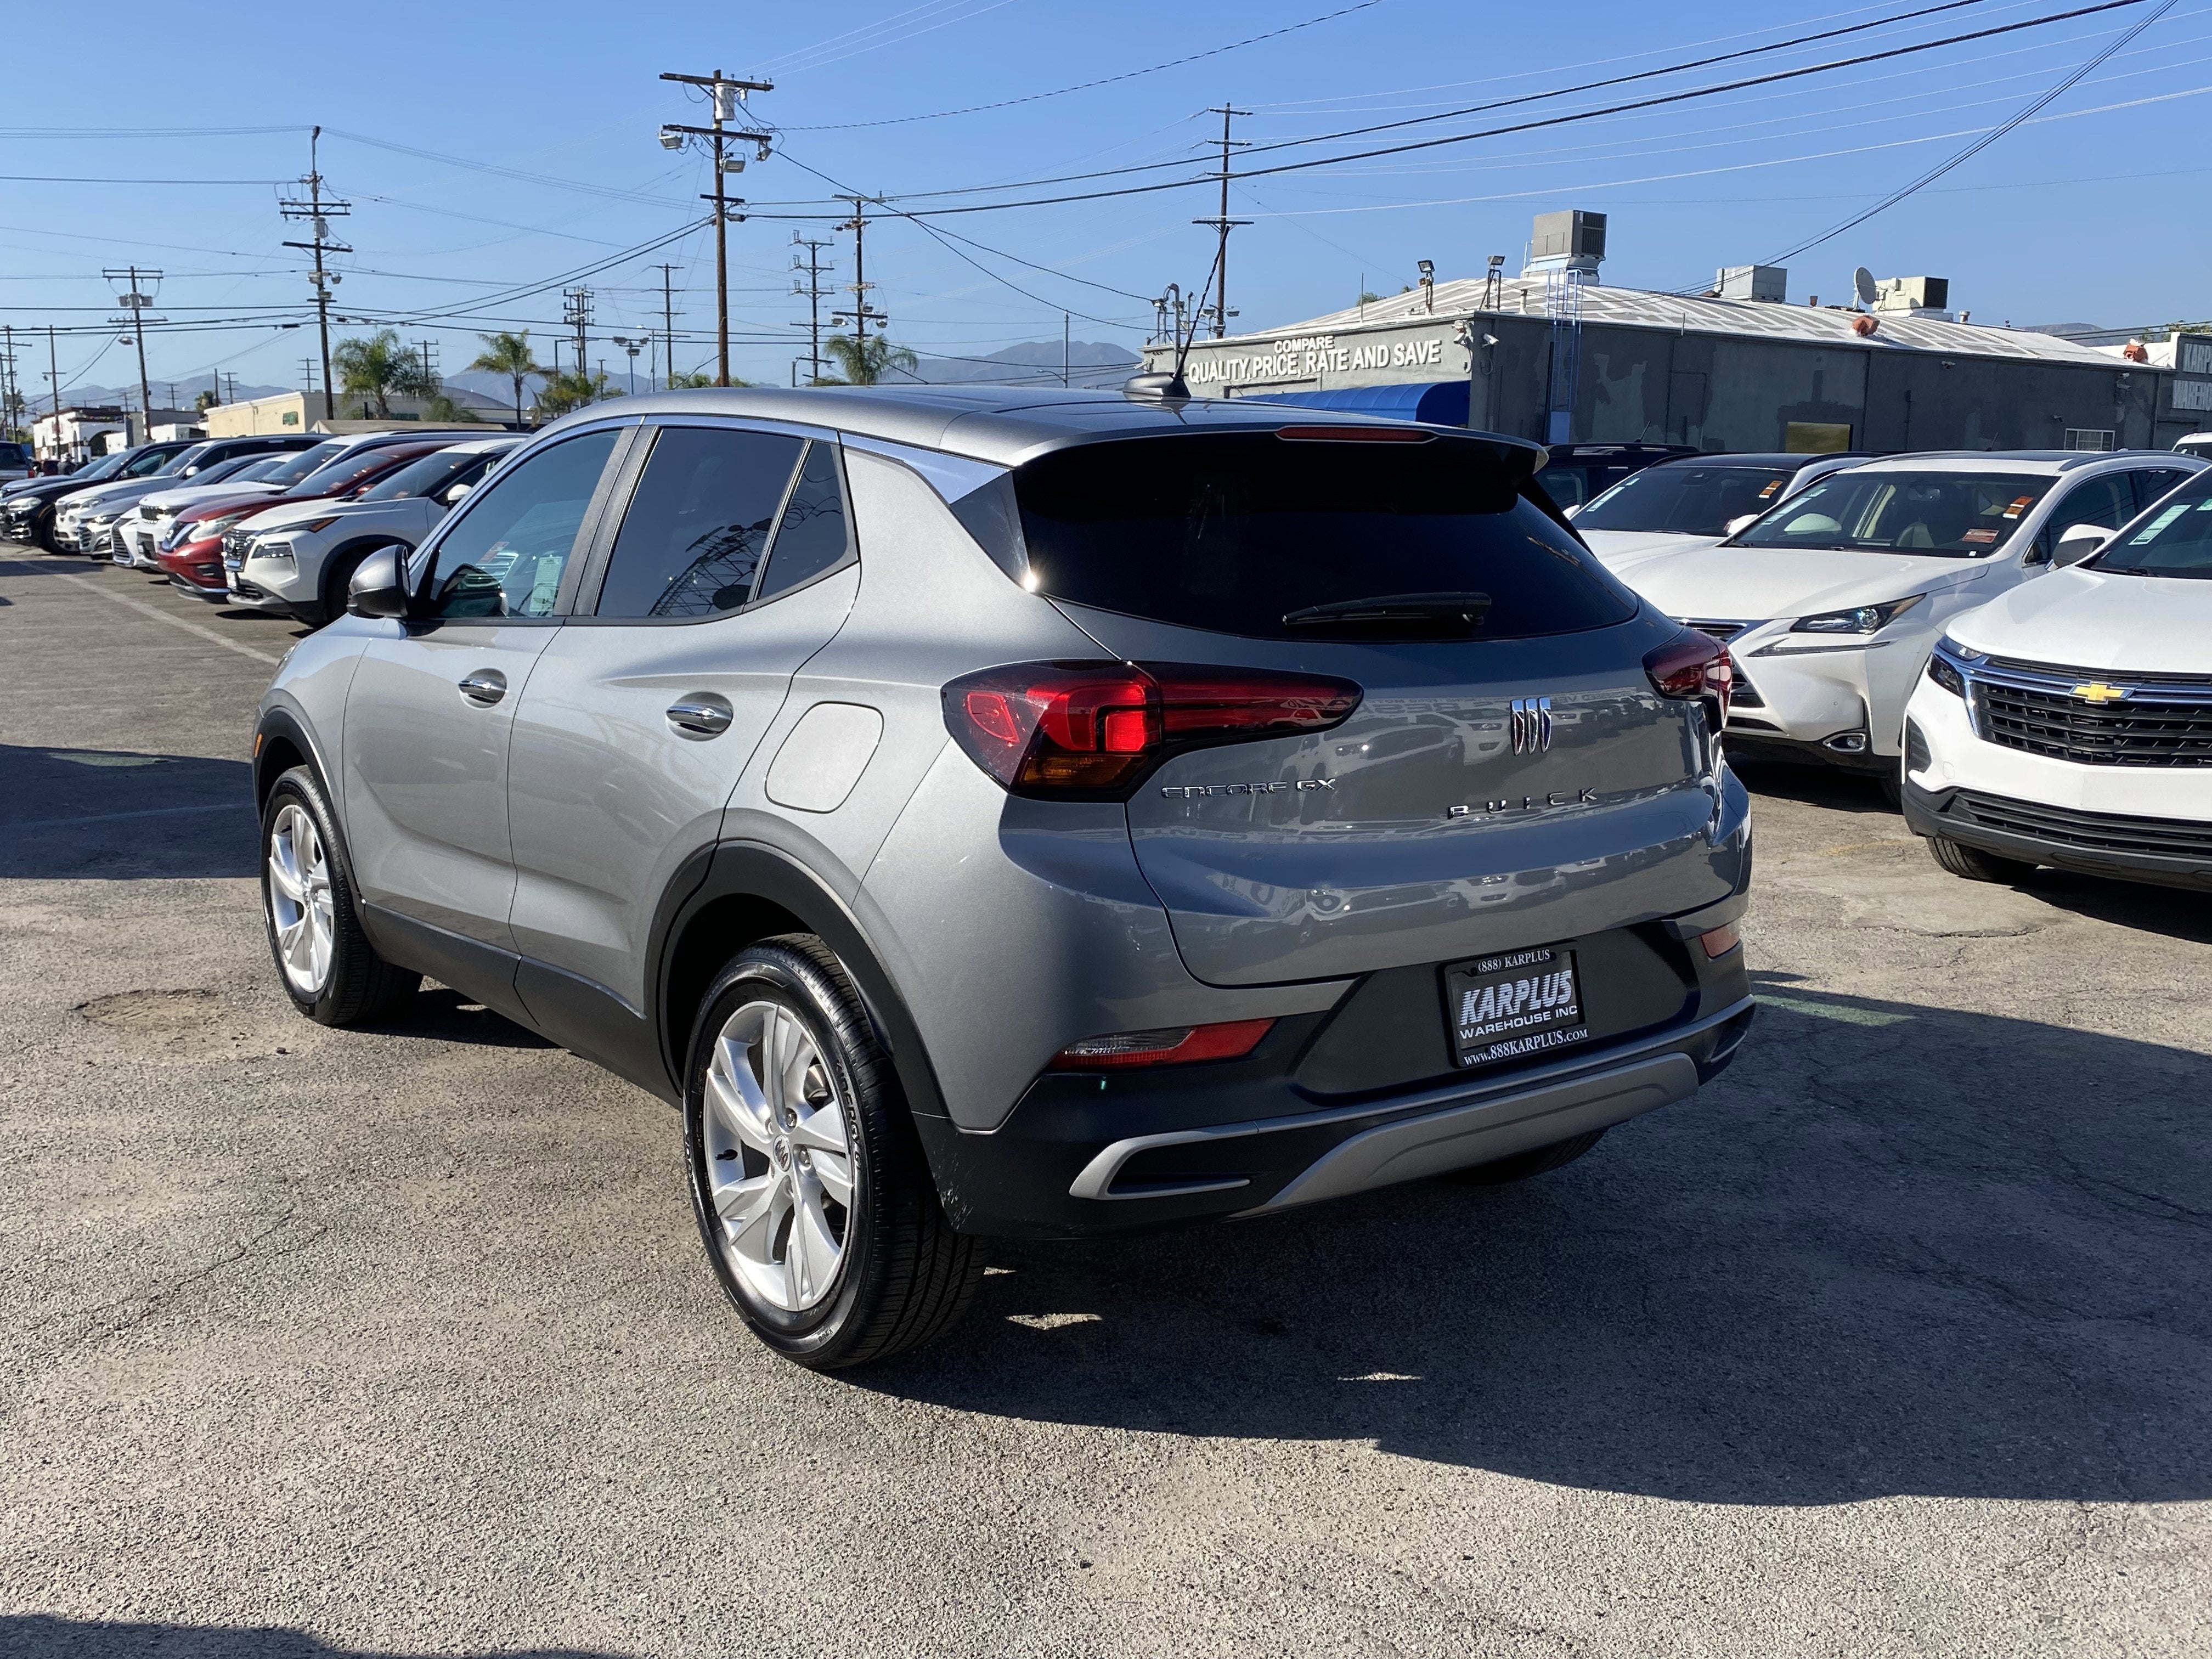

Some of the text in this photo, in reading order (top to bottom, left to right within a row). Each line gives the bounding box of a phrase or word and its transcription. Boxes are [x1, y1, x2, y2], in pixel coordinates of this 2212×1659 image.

[1274, 335, 1335, 354] COMPARE
[2183, 343, 2212, 374] KARP
[1188, 339, 1442, 385] QUALITY, PRICE, RATE AND SAVE
[1161, 778, 1336, 799] ENCORE GX
[1447, 787, 1598, 820] BUICK
[1477, 949, 1550, 973] (888) KARPLUS
[1458, 969, 1572, 1025] KARPLUS
[1459, 1005, 1578, 1040] WAREHOUSE INC
